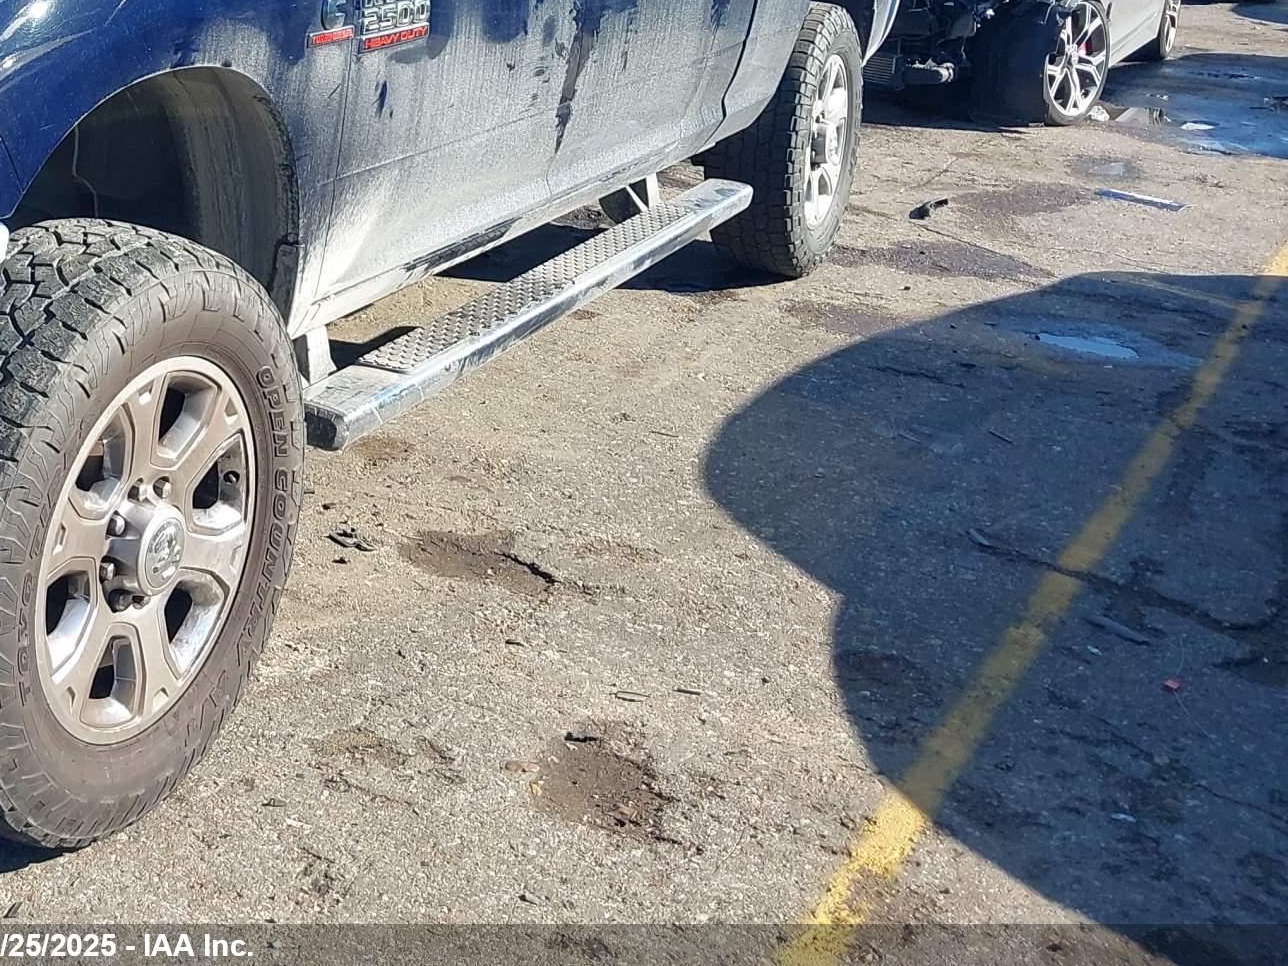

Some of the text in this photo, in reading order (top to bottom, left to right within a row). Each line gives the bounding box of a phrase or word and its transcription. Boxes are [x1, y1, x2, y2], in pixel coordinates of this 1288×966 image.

[364, 25, 428, 49] HEAVY DUTY
[255, 365, 289, 460] OPEN
[237, 465, 289, 668] COUNTRY
[16, 570, 34, 707] TOYO
